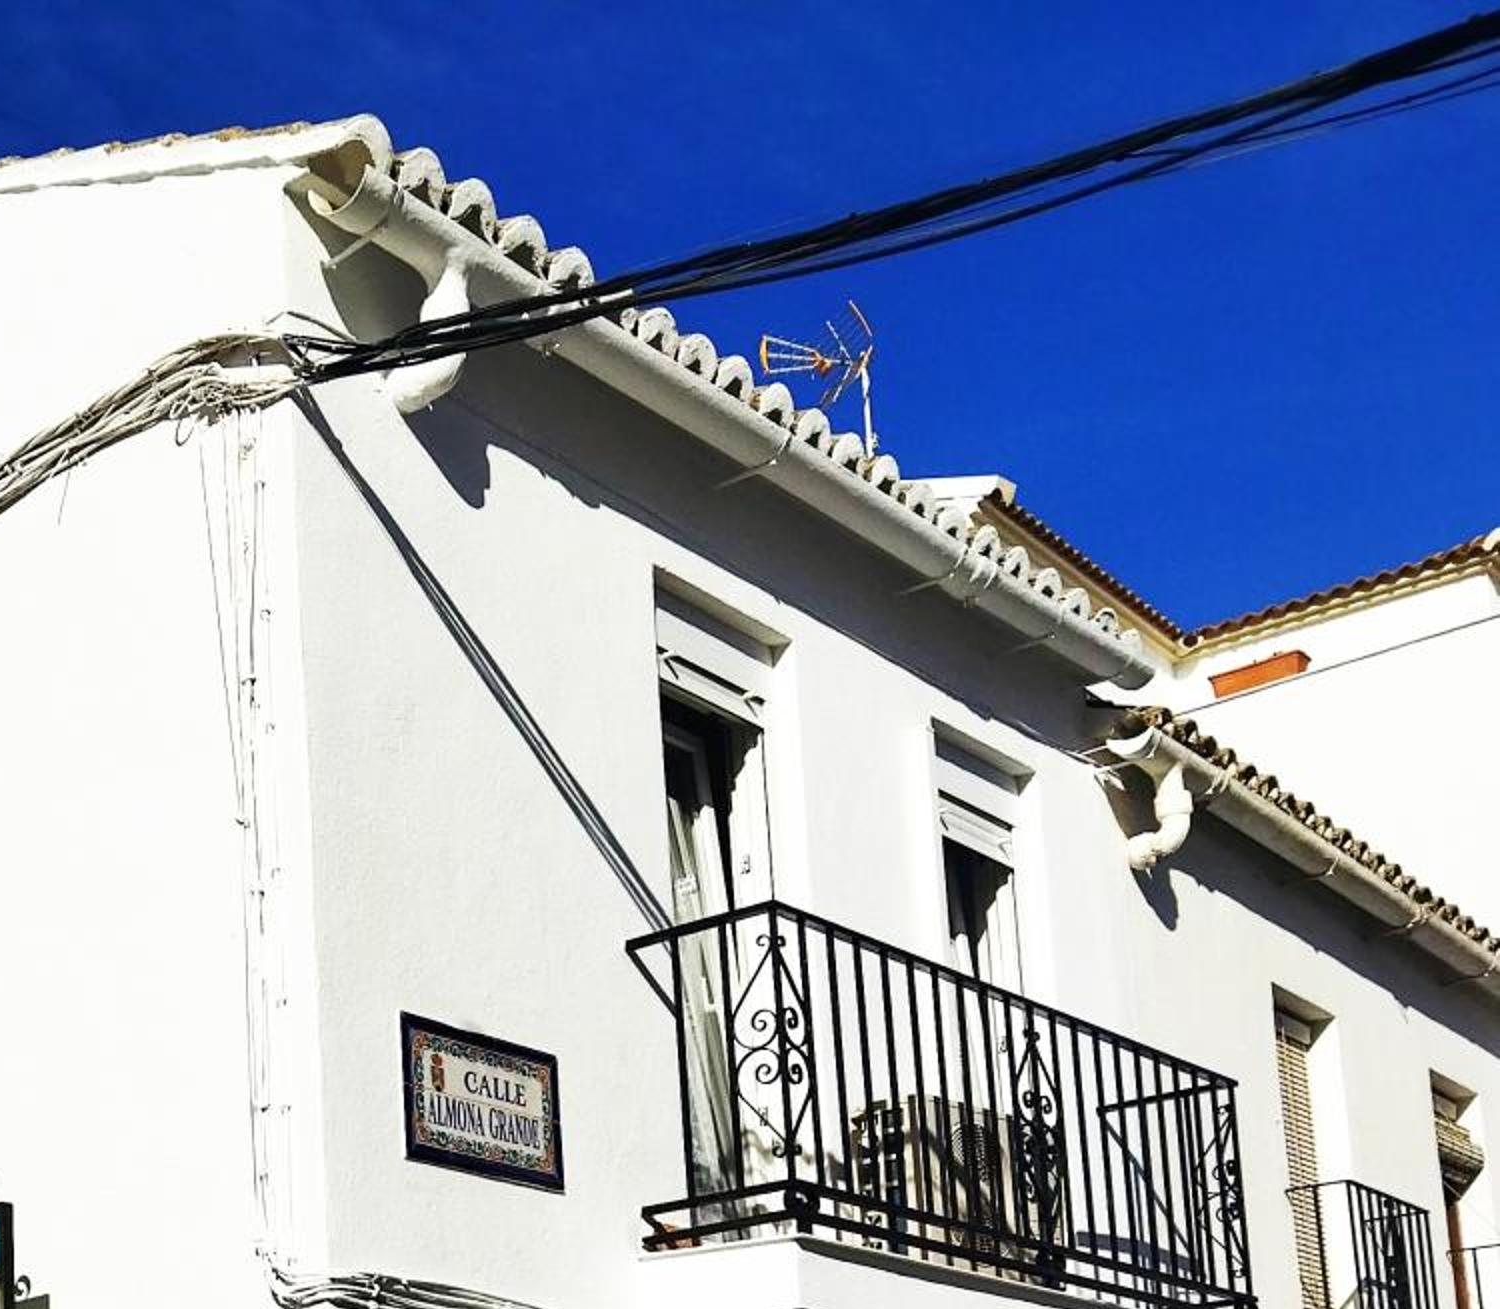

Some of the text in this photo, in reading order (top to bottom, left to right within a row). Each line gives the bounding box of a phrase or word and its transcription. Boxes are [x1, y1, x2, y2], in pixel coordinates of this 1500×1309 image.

[464, 1071, 526, 1106] CALLE
[427, 1094, 541, 1150] ALMONA GRANDE
